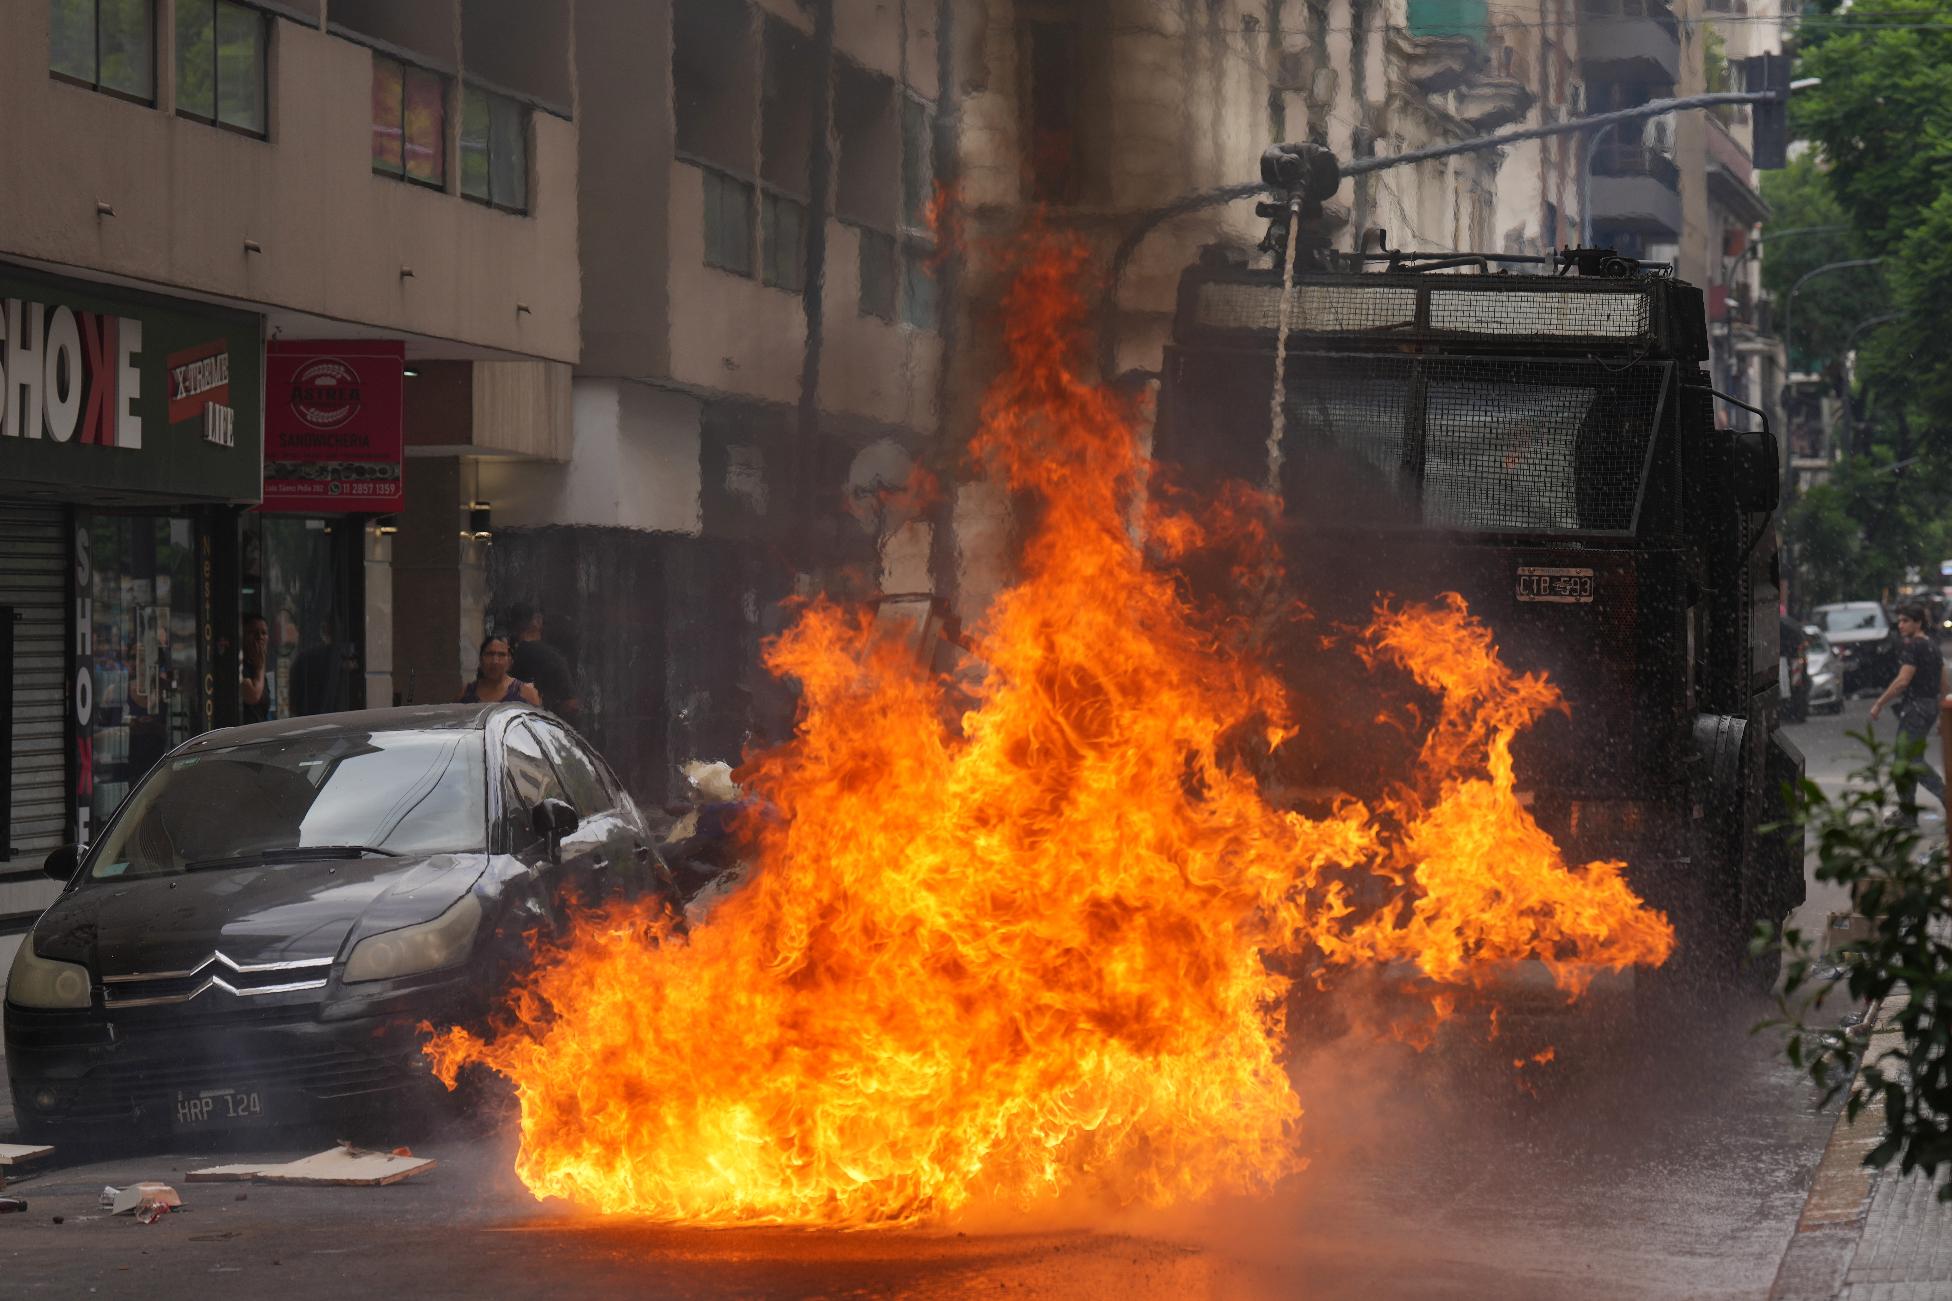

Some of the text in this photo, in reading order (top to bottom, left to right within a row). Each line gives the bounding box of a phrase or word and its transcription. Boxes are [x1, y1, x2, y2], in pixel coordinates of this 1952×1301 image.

[0, 298, 142, 449] HOKE
[343, 484, 396, 495] 11 2857 1359
[1520, 576, 1591, 596] CTB 593
[177, 1092, 261, 1123] HRP 124
